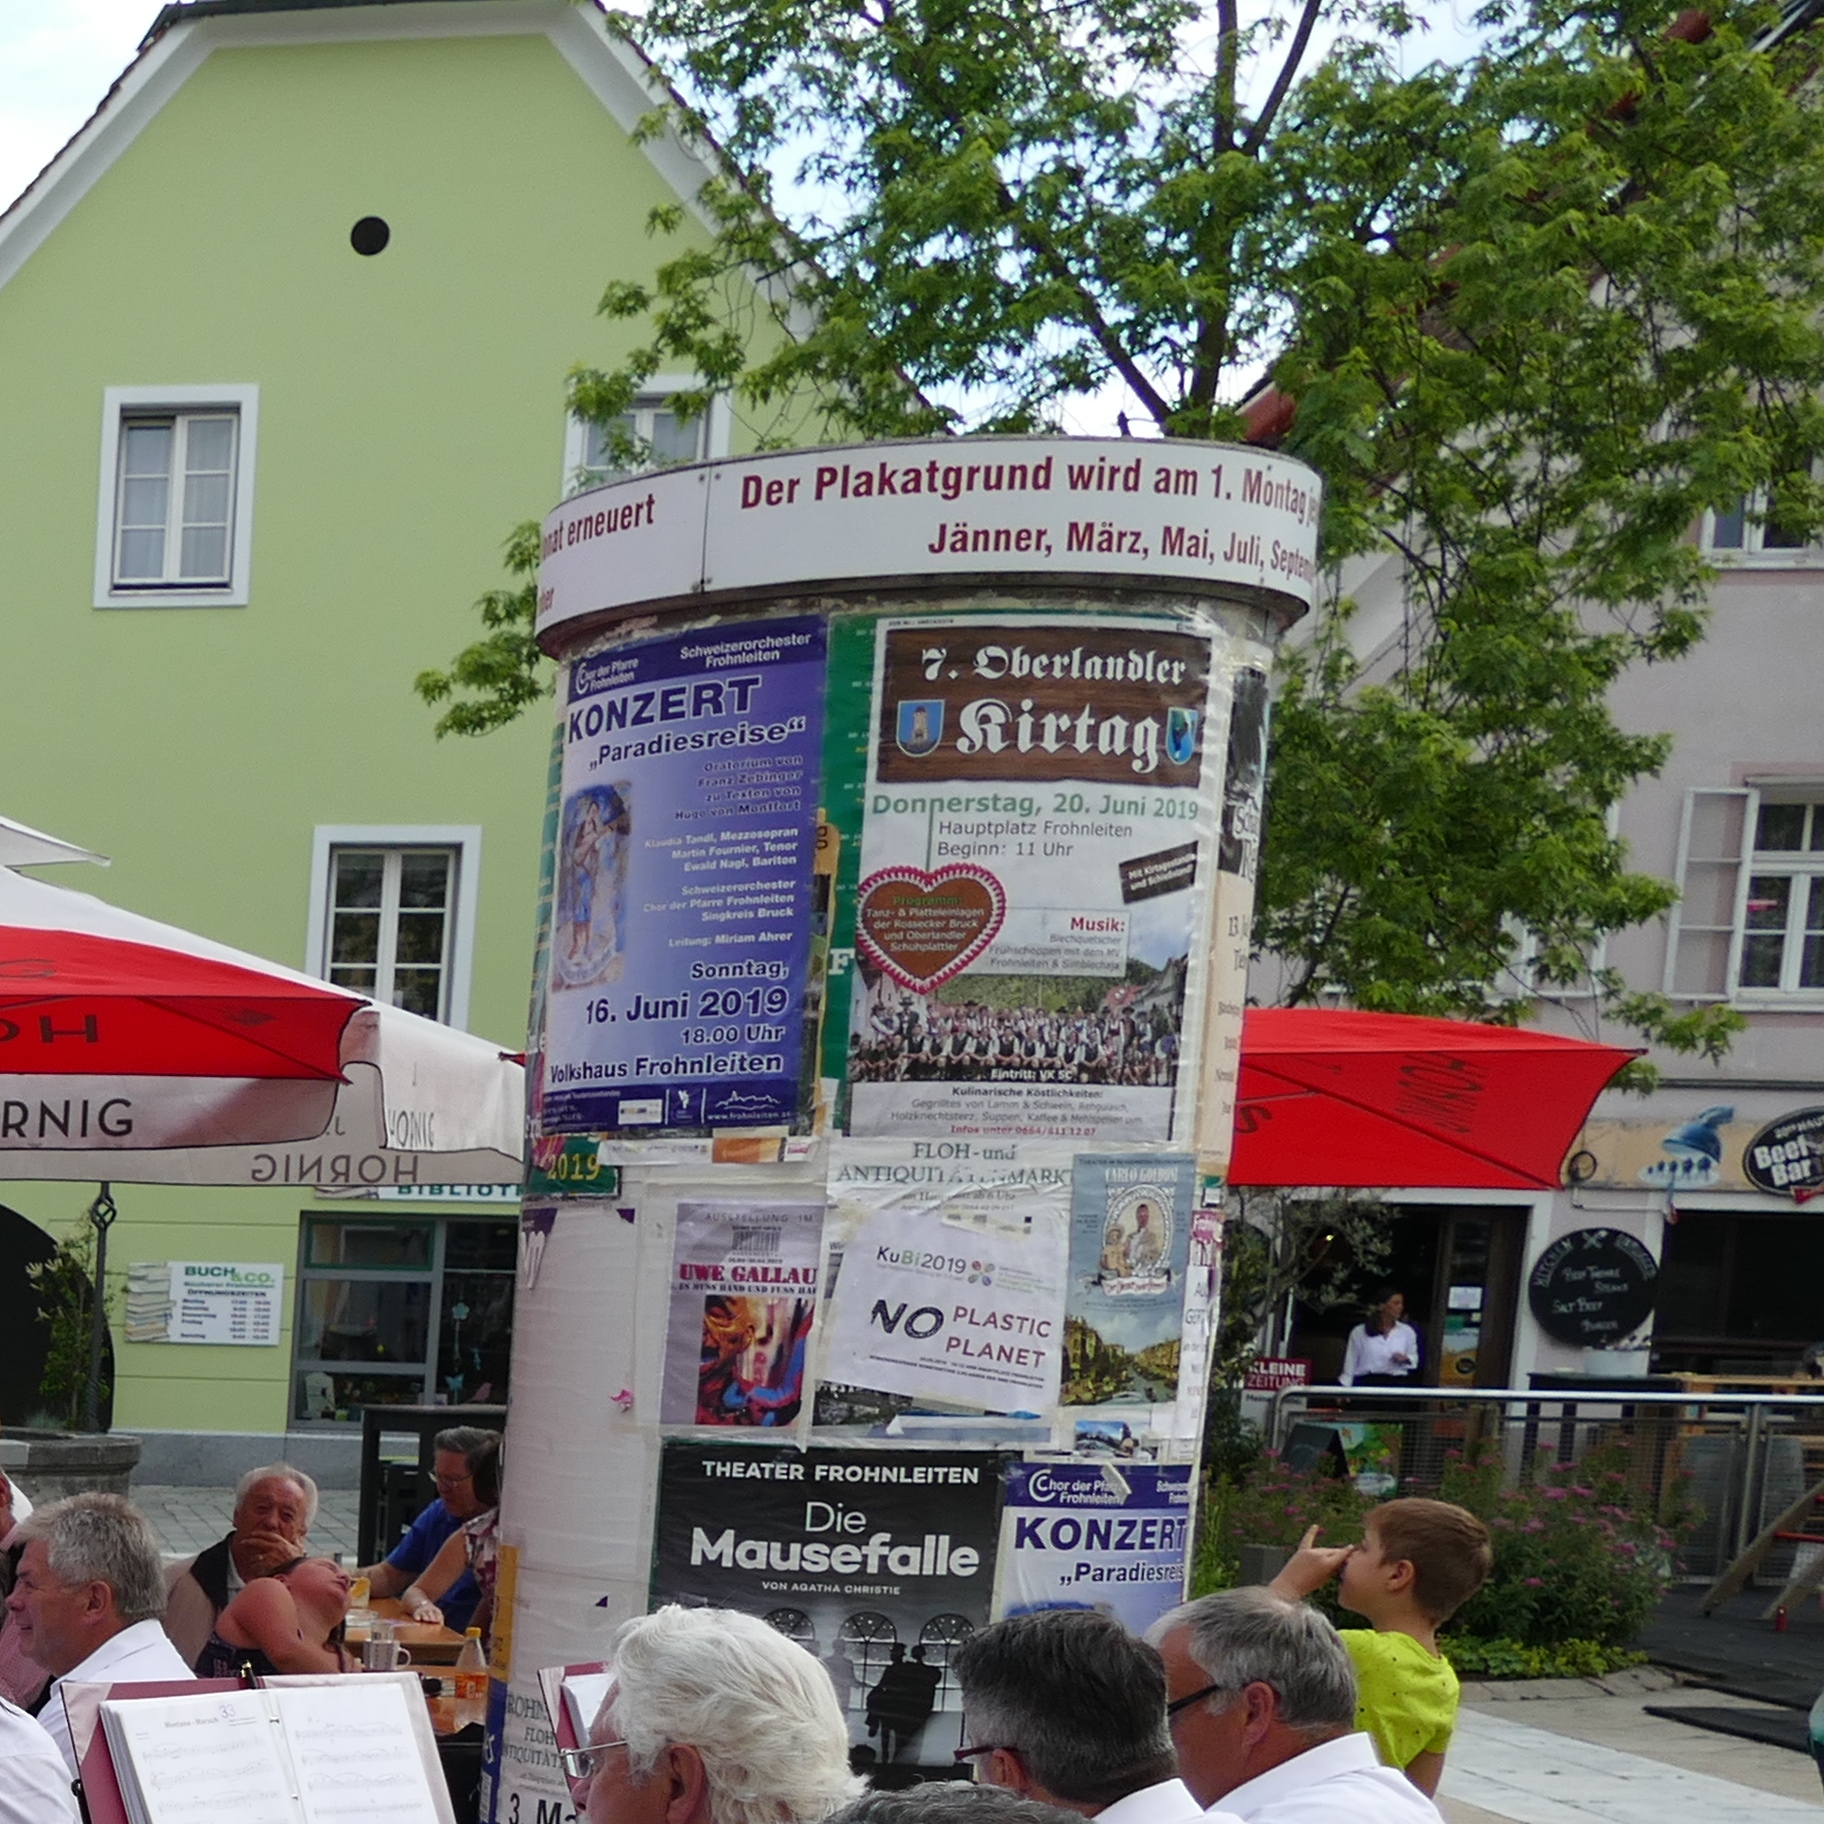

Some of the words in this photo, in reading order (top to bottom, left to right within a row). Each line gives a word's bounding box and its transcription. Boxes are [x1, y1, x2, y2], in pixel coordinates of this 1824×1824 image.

[741, 475, 800, 509] Der
[816, 455, 1052, 501] Plakatgrund
[1068, 456, 1142, 492] wird
[1155, 467, 1198, 496] am
[1212, 464, 1231, 500] 1.
[1242, 469, 1306, 524] Montag
[568, 494, 655, 547] erneuert
[929, 522, 1052, 557] Jänner,
[1067, 521, 1149, 558] März,
[1162, 526, 1214, 563] Mai,
[1224, 532, 1265, 570] Juli,
[680, 633, 811, 660] Schweizerorchester
[706, 649, 780, 668] Frohnleiten
[921, 648, 959, 681] 7.
[568, 677, 760, 744] KONZERT
[956, 698, 1160, 773] Kirtag
[704, 758, 772, 772] Oratorium
[776, 755, 803, 765] von
[776, 786, 801, 796] von
[872, 793, 1042, 816] Donnerstag,
[1054, 793, 1090, 814] 20.
[1100, 797, 1146, 816] Juni
[1154, 799, 1198, 820] 2019
[720, 827, 798, 843] Mezzosopran
[940, 820, 1036, 837] Hauptplatz
[1044, 821, 1132, 837] Frohnleiten
[764, 841, 798, 852] Tenor
[937, 842, 1006, 859] Beginn:
[1017, 843, 1036, 856] 11
[1043, 844, 1073, 857] Uhr
[684, 860, 717, 872] Ewald
[752, 856, 796, 866] Bariton
[682, 880, 796, 896] Schweizerorchester
[727, 894, 794, 906] Frohnleiten
[702, 910, 754, 922] Singkreis
[758, 907, 793, 918] Bruck
[1070, 918, 1125, 932] Musik:
[715, 933, 754, 944] Miriam
[758, 932, 792, 942] Ahrer
[690, 961, 789, 980] Sonntag,
[586, 999, 616, 1025] 16.
[627, 992, 688, 1021] Juni
[699, 987, 788, 1017] 2019
[682, 1026, 738, 1045] 18.00
[746, 1024, 784, 1042] Uhr
[551, 1060, 627, 1084] Volkshaus
[635, 1053, 782, 1077] Frohnleiten
[952, 1088, 1022, 1098] Kulinarische
[951, 1126, 980, 1134] Infos
[984, 1126, 1012, 1134] unter
[548, 1153, 601, 1181] 2019
[1771, 1159, 1811, 1187] Bar
[706, 1213, 788, 1222] AUSSTELLUNG
[876, 1246, 967, 1274] KuBi2019
[185, 1266, 235, 1277] BUCH
[679, 1264, 725, 1281] UWE
[871, 1299, 944, 1339] NO
[953, 1305, 1051, 1338] PLASTIC
[946, 1337, 1045, 1368] PLANET
[1249, 1362, 1306, 1376] KLEINE
[702, 1461, 804, 1480] THEATER
[814, 1465, 979, 1484] FROHNLEITEN
[1072, 1481, 1092, 1491] der
[805, 1502, 867, 1533] Die
[690, 1527, 979, 1577] Mausefalle
[762, 1582, 787, 1591] VON
[791, 1583, 840, 1593] AGATHA
[844, 1585, 900, 1595] CHRISTIE
